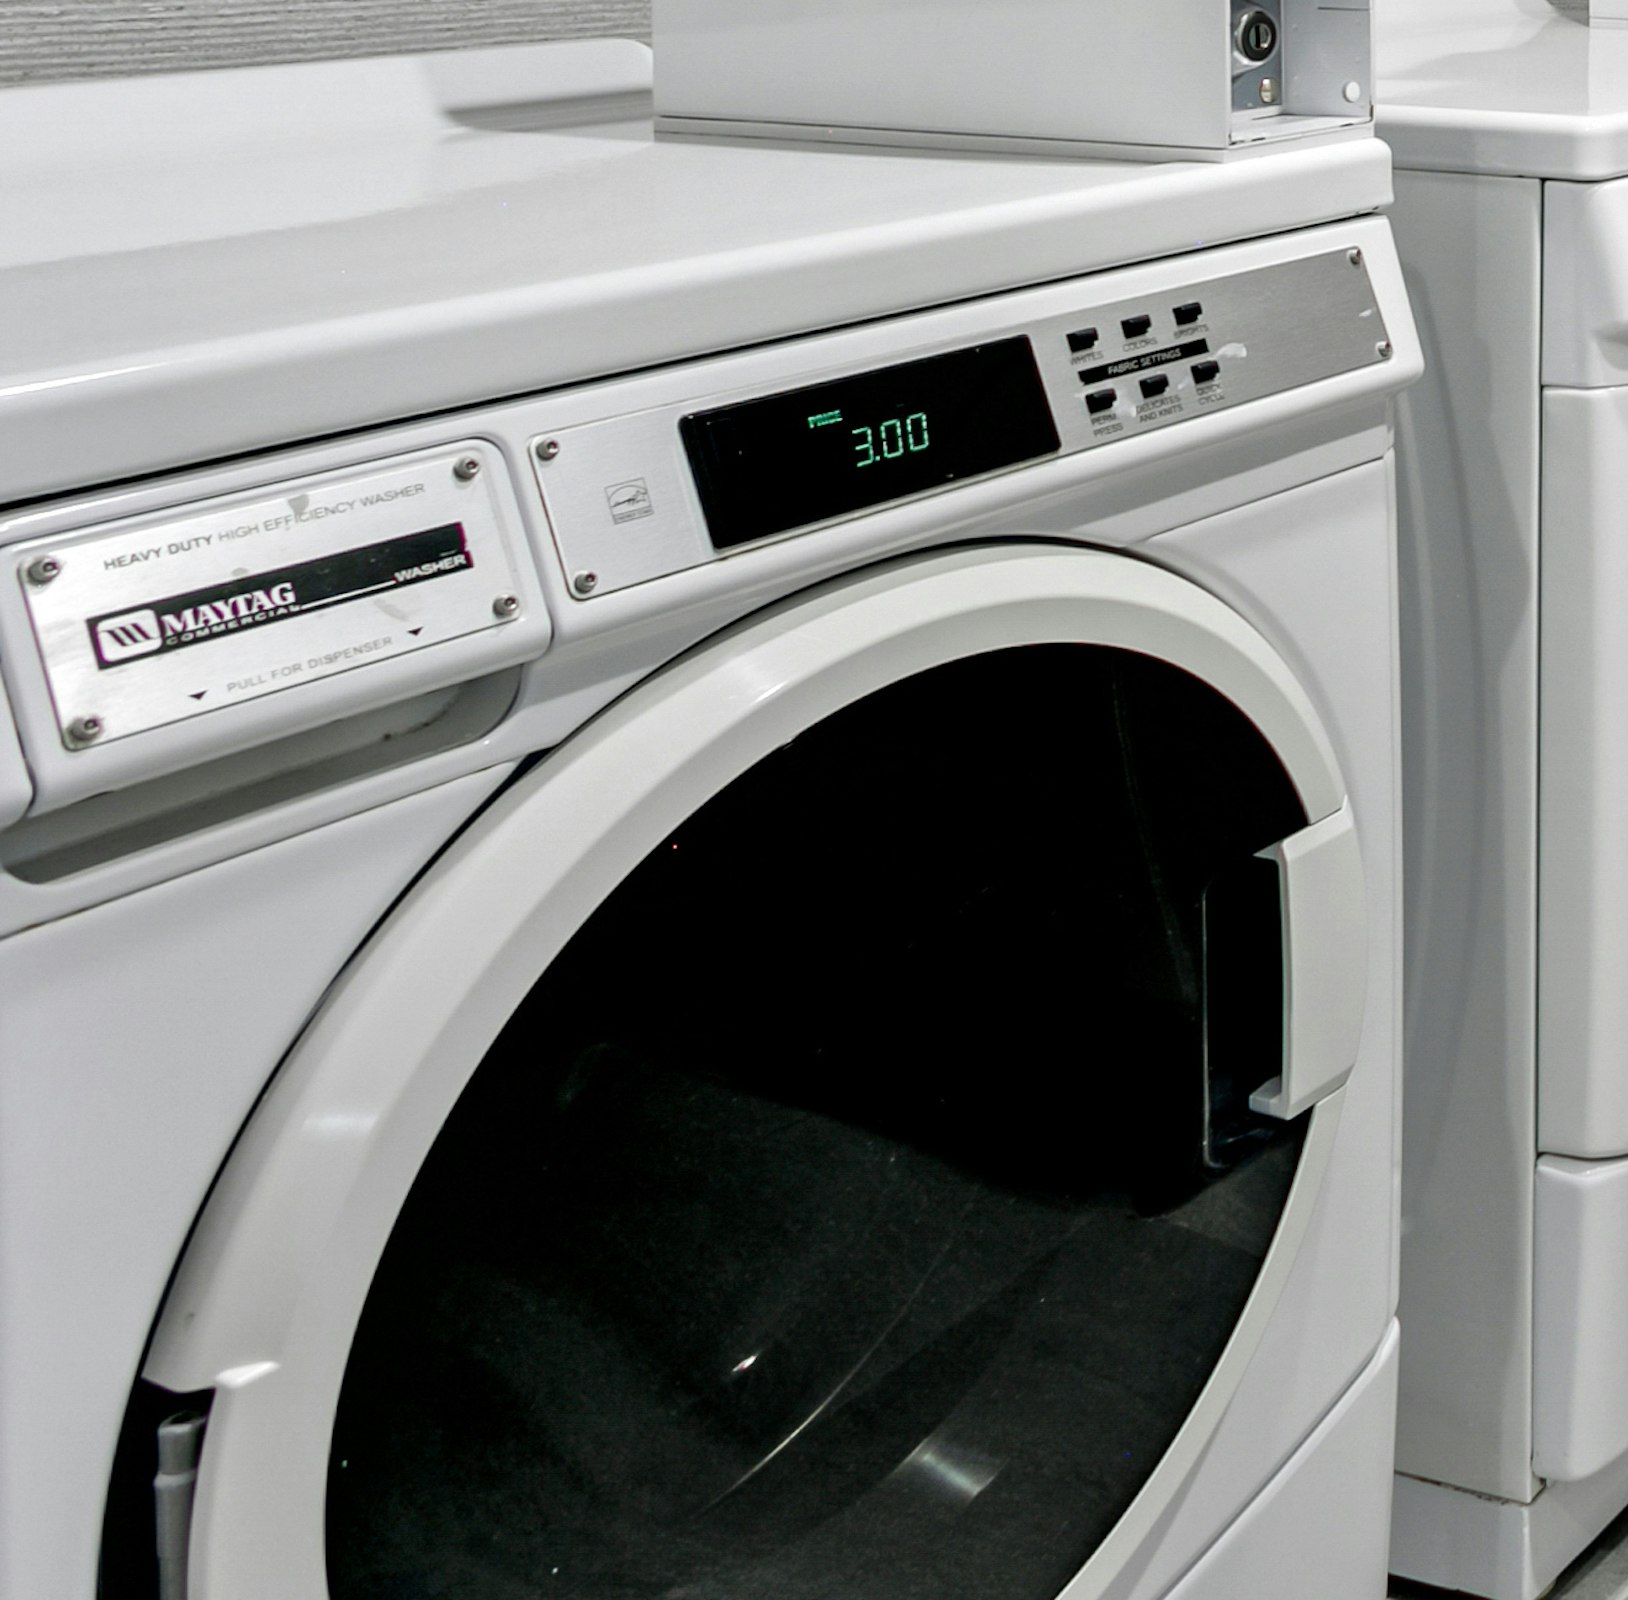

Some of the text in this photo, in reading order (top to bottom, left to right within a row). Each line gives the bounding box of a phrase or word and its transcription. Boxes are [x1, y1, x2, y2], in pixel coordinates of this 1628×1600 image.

[1070, 351, 1104, 366] WHITES
[1122, 337, 1158, 351] COLORS
[1107, 348, 1182, 375] FABRIC SETTINGS
[1139, 403, 1184, 424] AND KNITS
[851, 411, 930, 468] 3.00
[1093, 423, 1124, 437] PRESS
[103, 482, 426, 571] HEAVY DUTY HIGH EFFICIENCY WASHER
[393, 553, 468, 583] WASHER
[160, 581, 297, 637] MAYTAG
[165, 603, 300, 646] COMMERCIAL
[226, 636, 393, 693] PULL FOR DISPENSER
